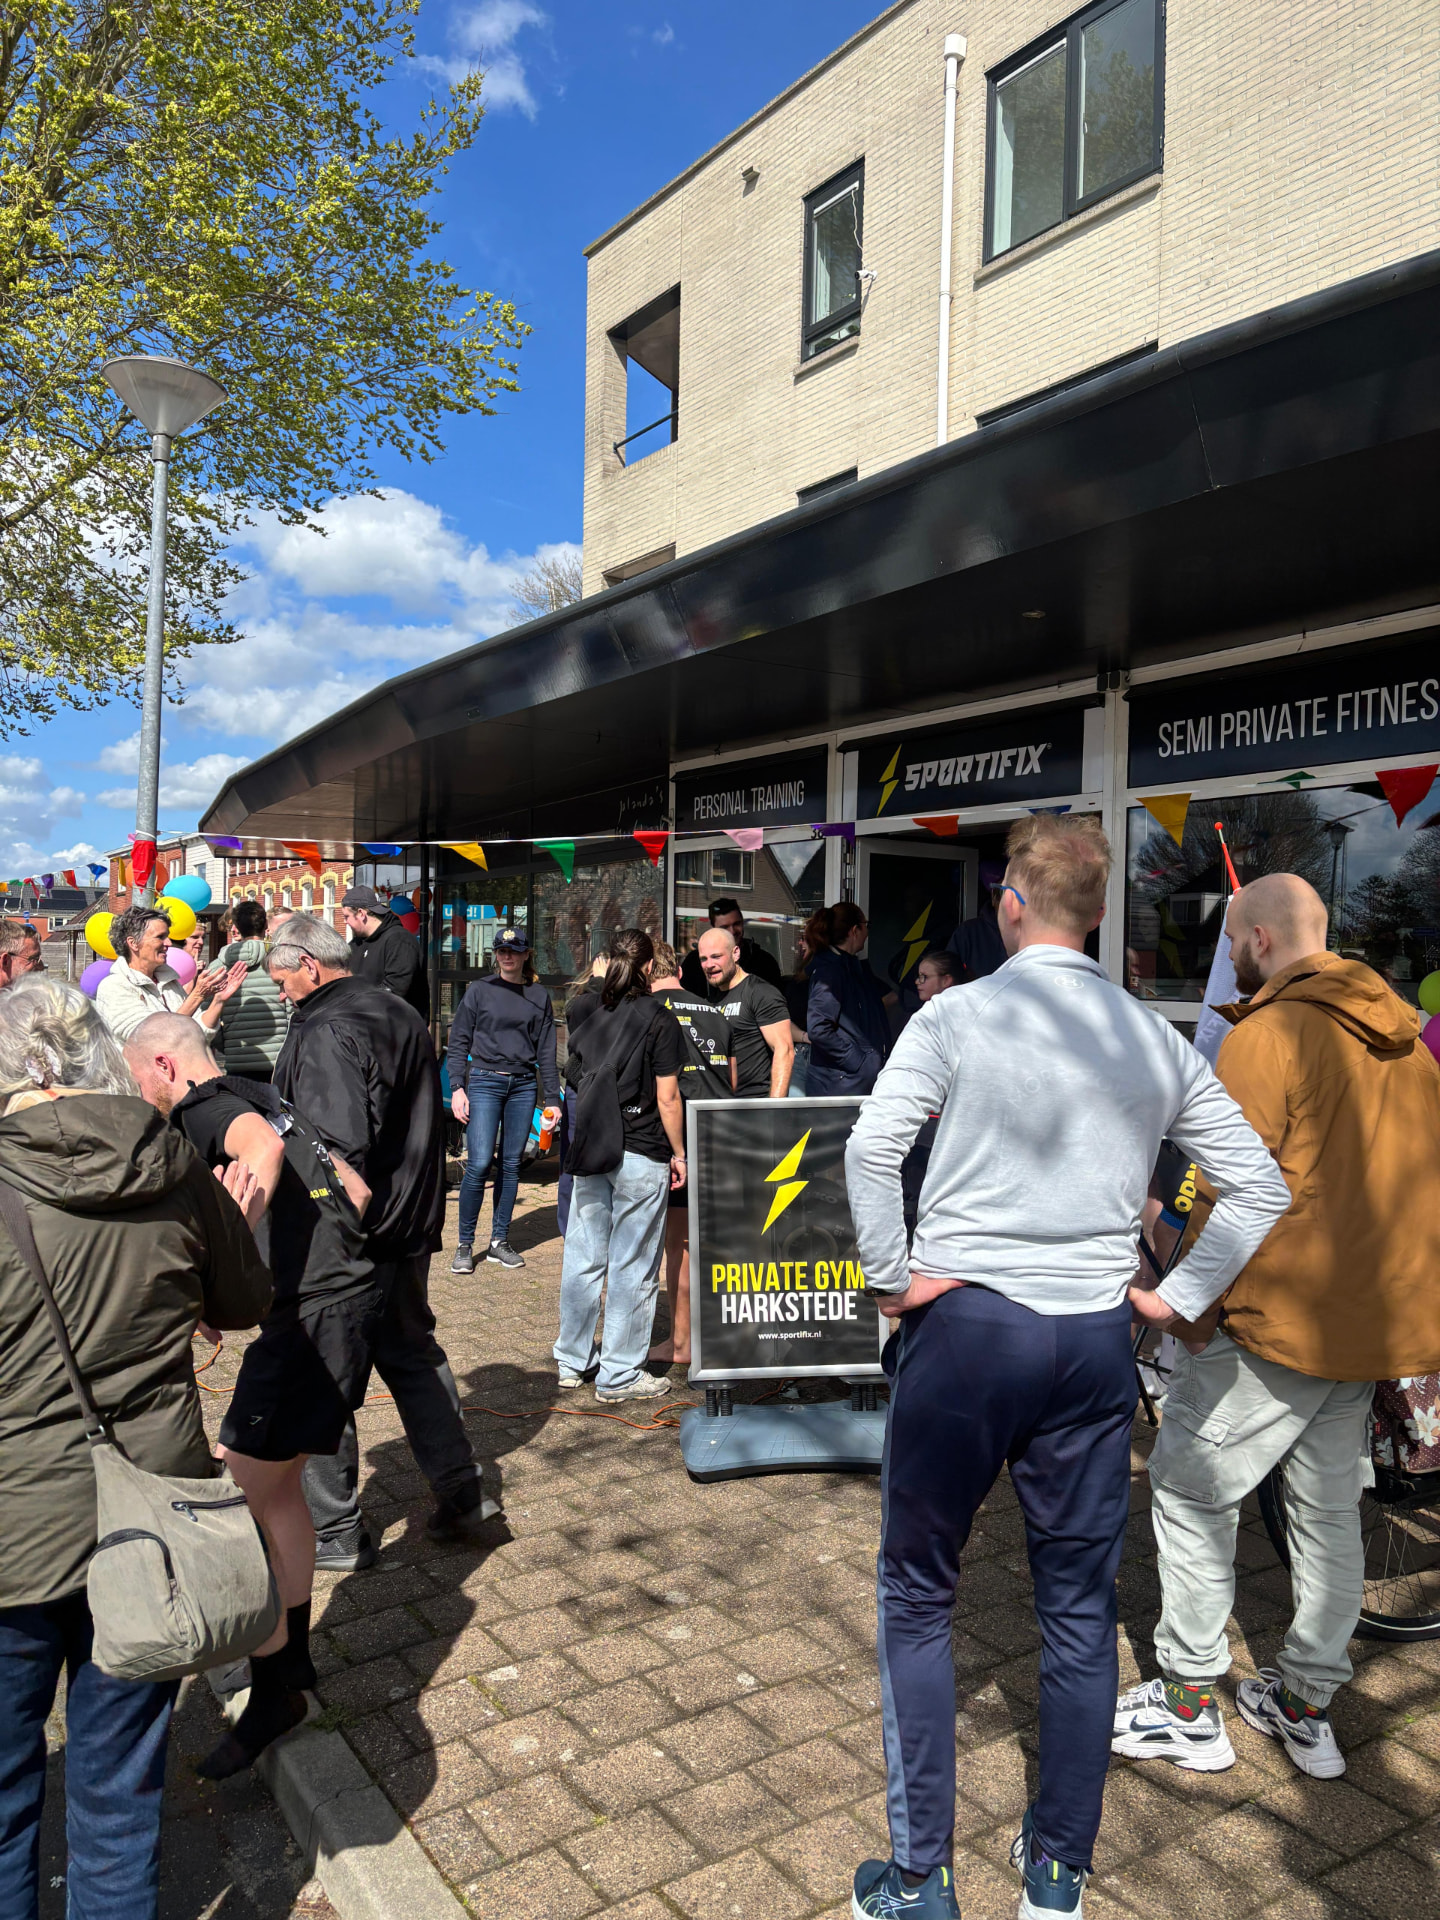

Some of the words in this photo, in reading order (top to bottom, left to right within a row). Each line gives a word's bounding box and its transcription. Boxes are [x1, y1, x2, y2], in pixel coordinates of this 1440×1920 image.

[1158, 715, 1213, 758] SEMI
[1219, 696, 1329, 749] PRIVATE
[1336, 678, 1440, 733] FITNES
[693, 789, 748, 820] PERSONAL
[751, 780, 805, 812] TRAINING
[711, 1261, 808, 1293] PRIVATE
[814, 1260, 866, 1290] GYM
[721, 1290, 858, 1324] HARKSTEDE
[758, 1330, 822, 1341] www.sportifix.nl
